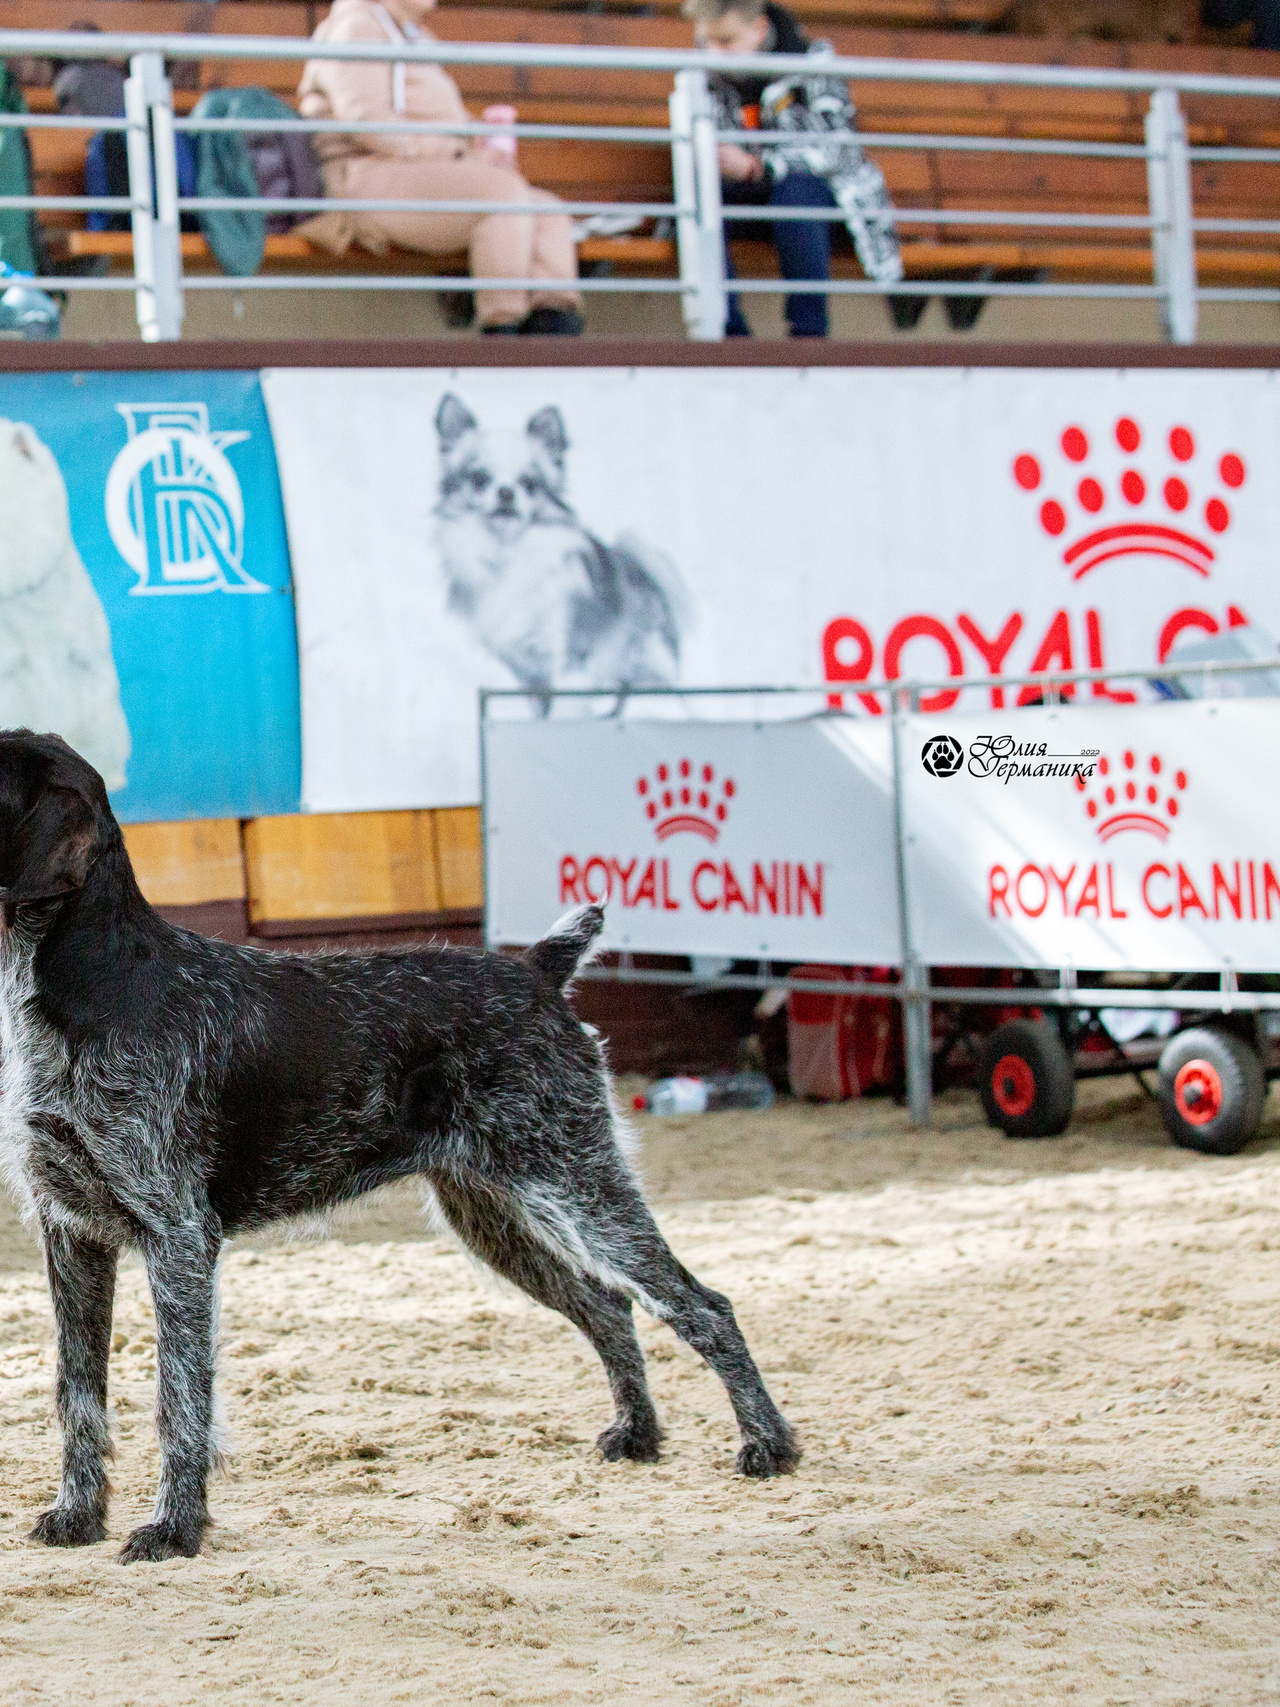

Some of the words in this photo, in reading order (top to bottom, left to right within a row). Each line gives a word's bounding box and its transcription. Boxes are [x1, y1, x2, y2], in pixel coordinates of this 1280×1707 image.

[822, 606, 1137, 717] ROYAL
[560, 854, 681, 911] ROYAL
[689, 859, 824, 917] CANIN
[989, 863, 1127, 918] ROYAL
